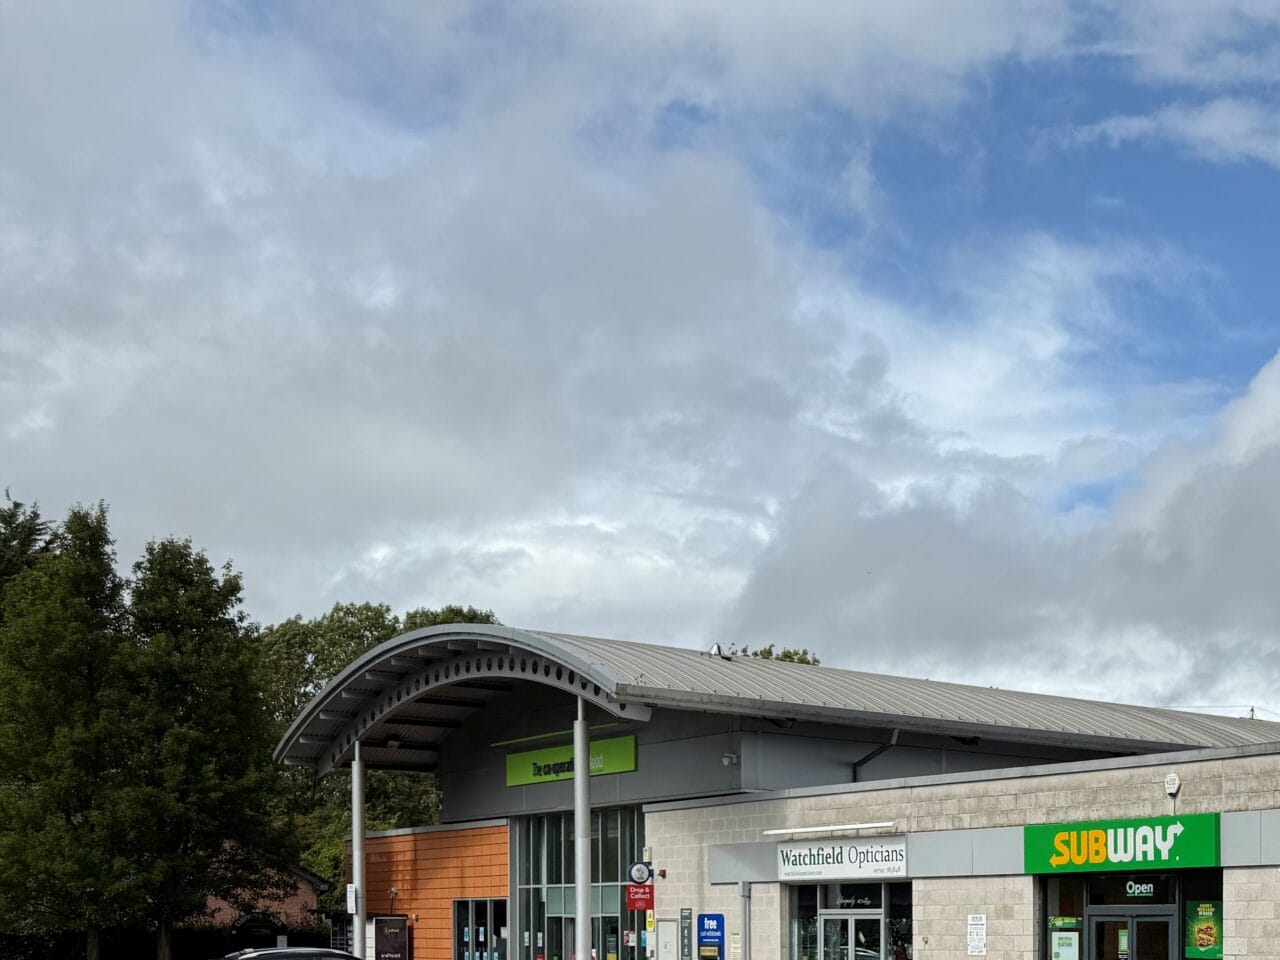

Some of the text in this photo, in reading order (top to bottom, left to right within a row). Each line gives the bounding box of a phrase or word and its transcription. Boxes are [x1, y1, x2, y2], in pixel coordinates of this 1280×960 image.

[1050, 820, 1184, 868] SUBWAY
[780, 845, 904, 869] Watchfield Opticians
[630, 886, 644, 894] Drop
[1126, 881, 1154, 895] Open
[704, 917, 717, 929] free
